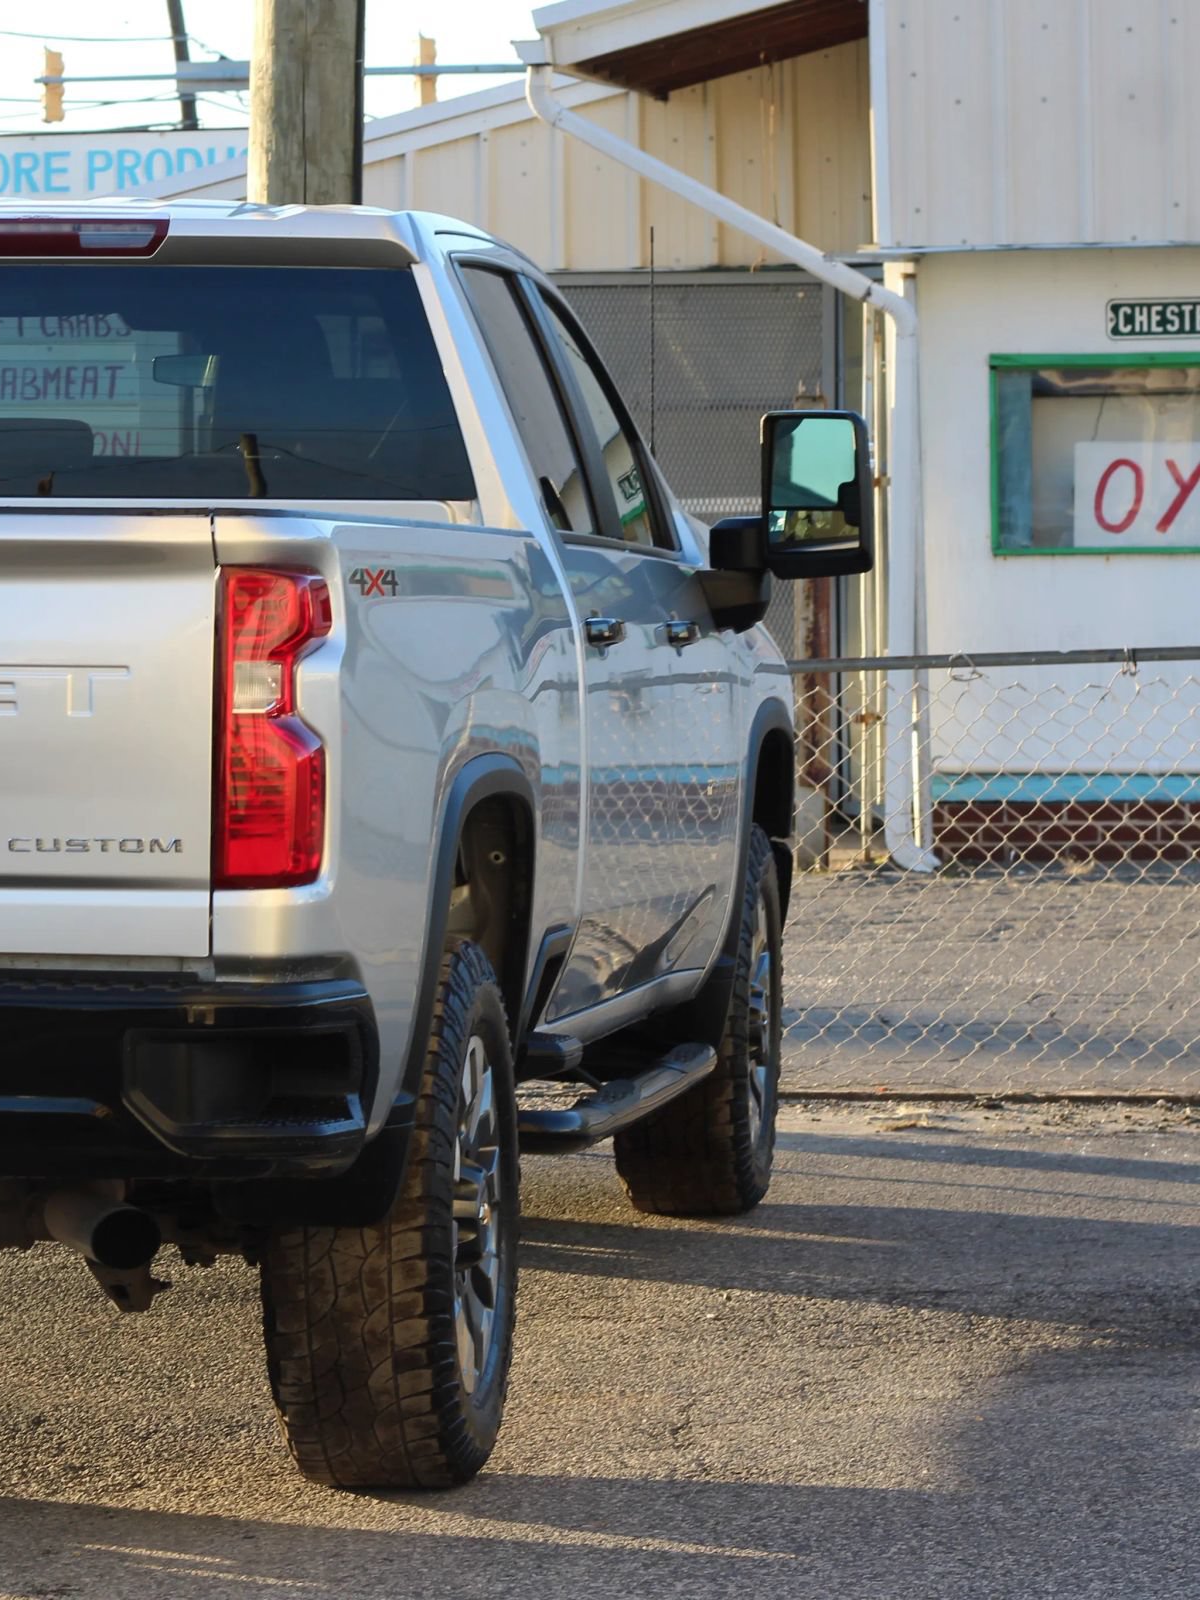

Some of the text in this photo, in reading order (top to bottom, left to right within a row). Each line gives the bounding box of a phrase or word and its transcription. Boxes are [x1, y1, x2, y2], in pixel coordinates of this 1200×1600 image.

[87, 147, 248, 192] PROD
[1093, 457, 1200, 535] OY
[349, 567, 399, 597] 4X4
[7, 838, 184, 854] CUSTOM
